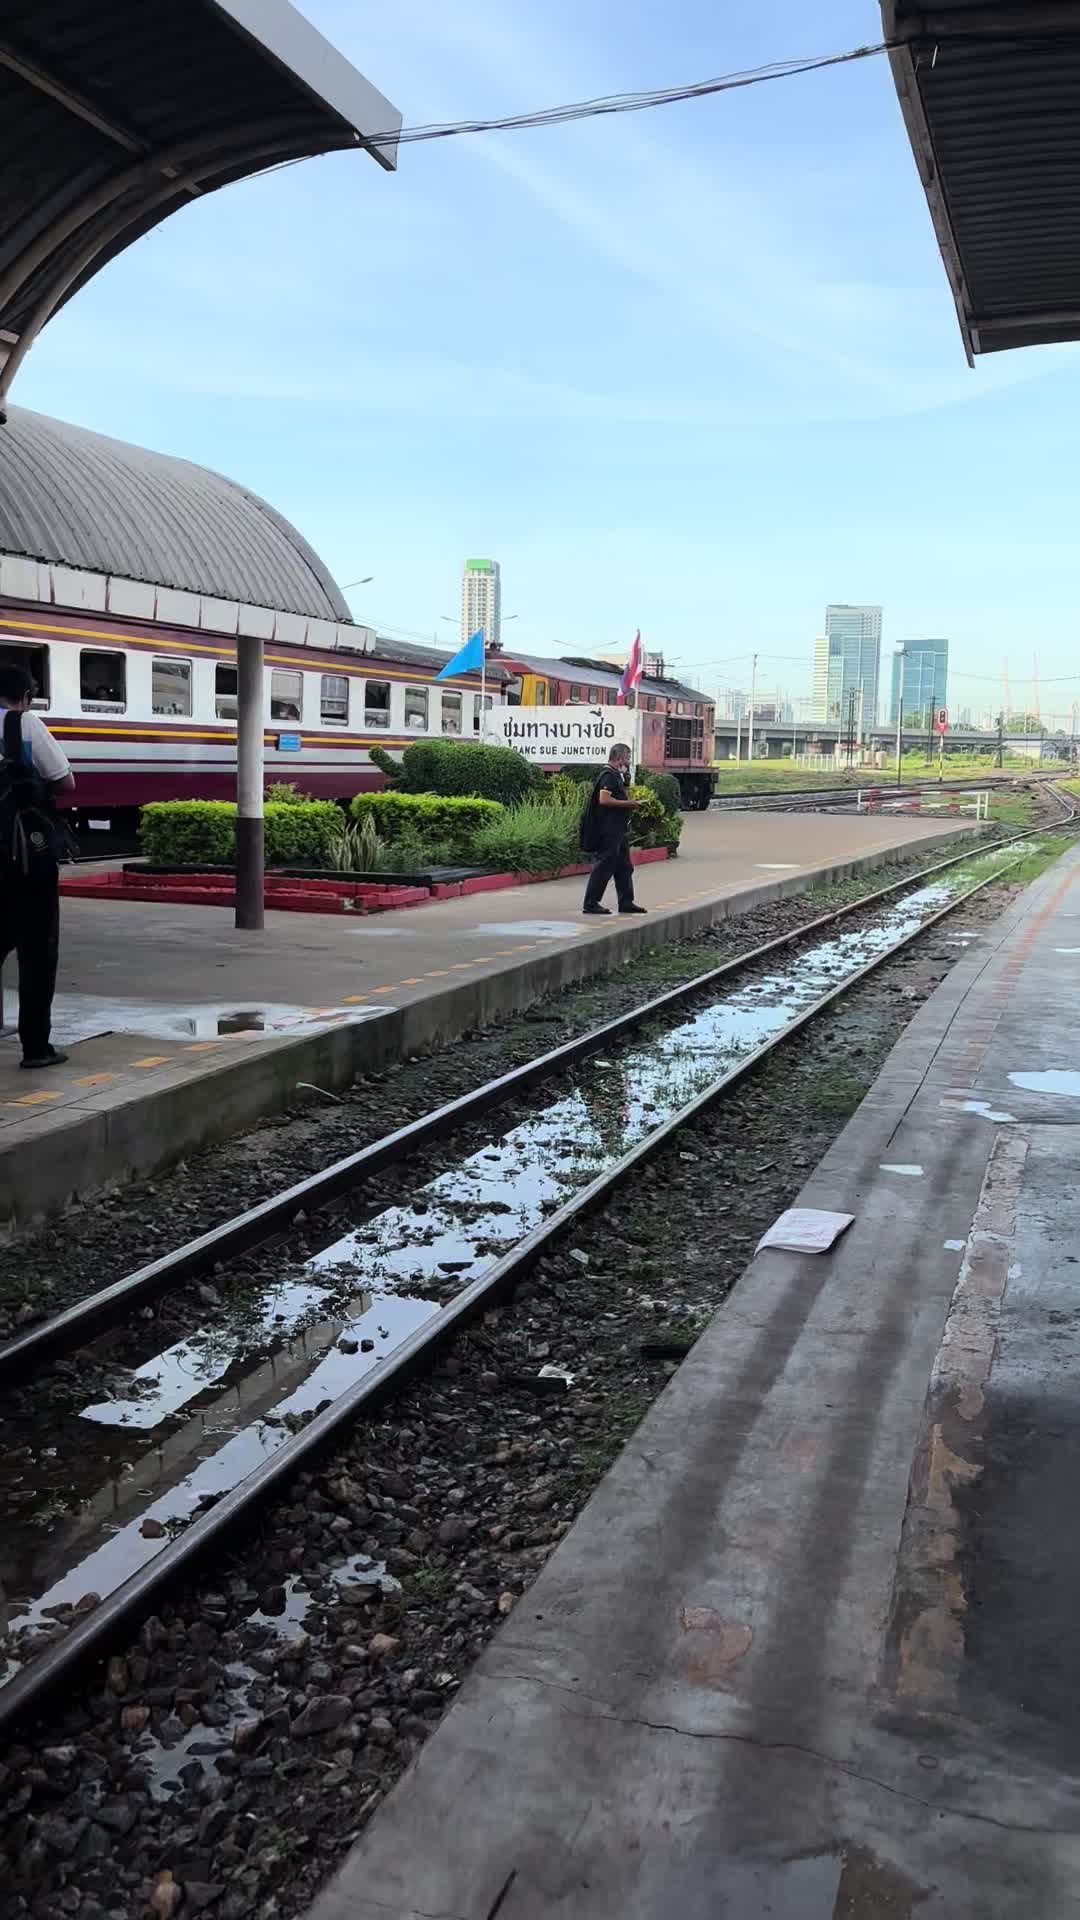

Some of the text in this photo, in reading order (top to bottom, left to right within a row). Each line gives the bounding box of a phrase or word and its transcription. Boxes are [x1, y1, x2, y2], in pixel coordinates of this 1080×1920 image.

[504, 708, 615, 747] ชุมทางบางซื่อ
[539, 746, 558, 756] SUE
[561, 746, 607, 756] JUNCTION
